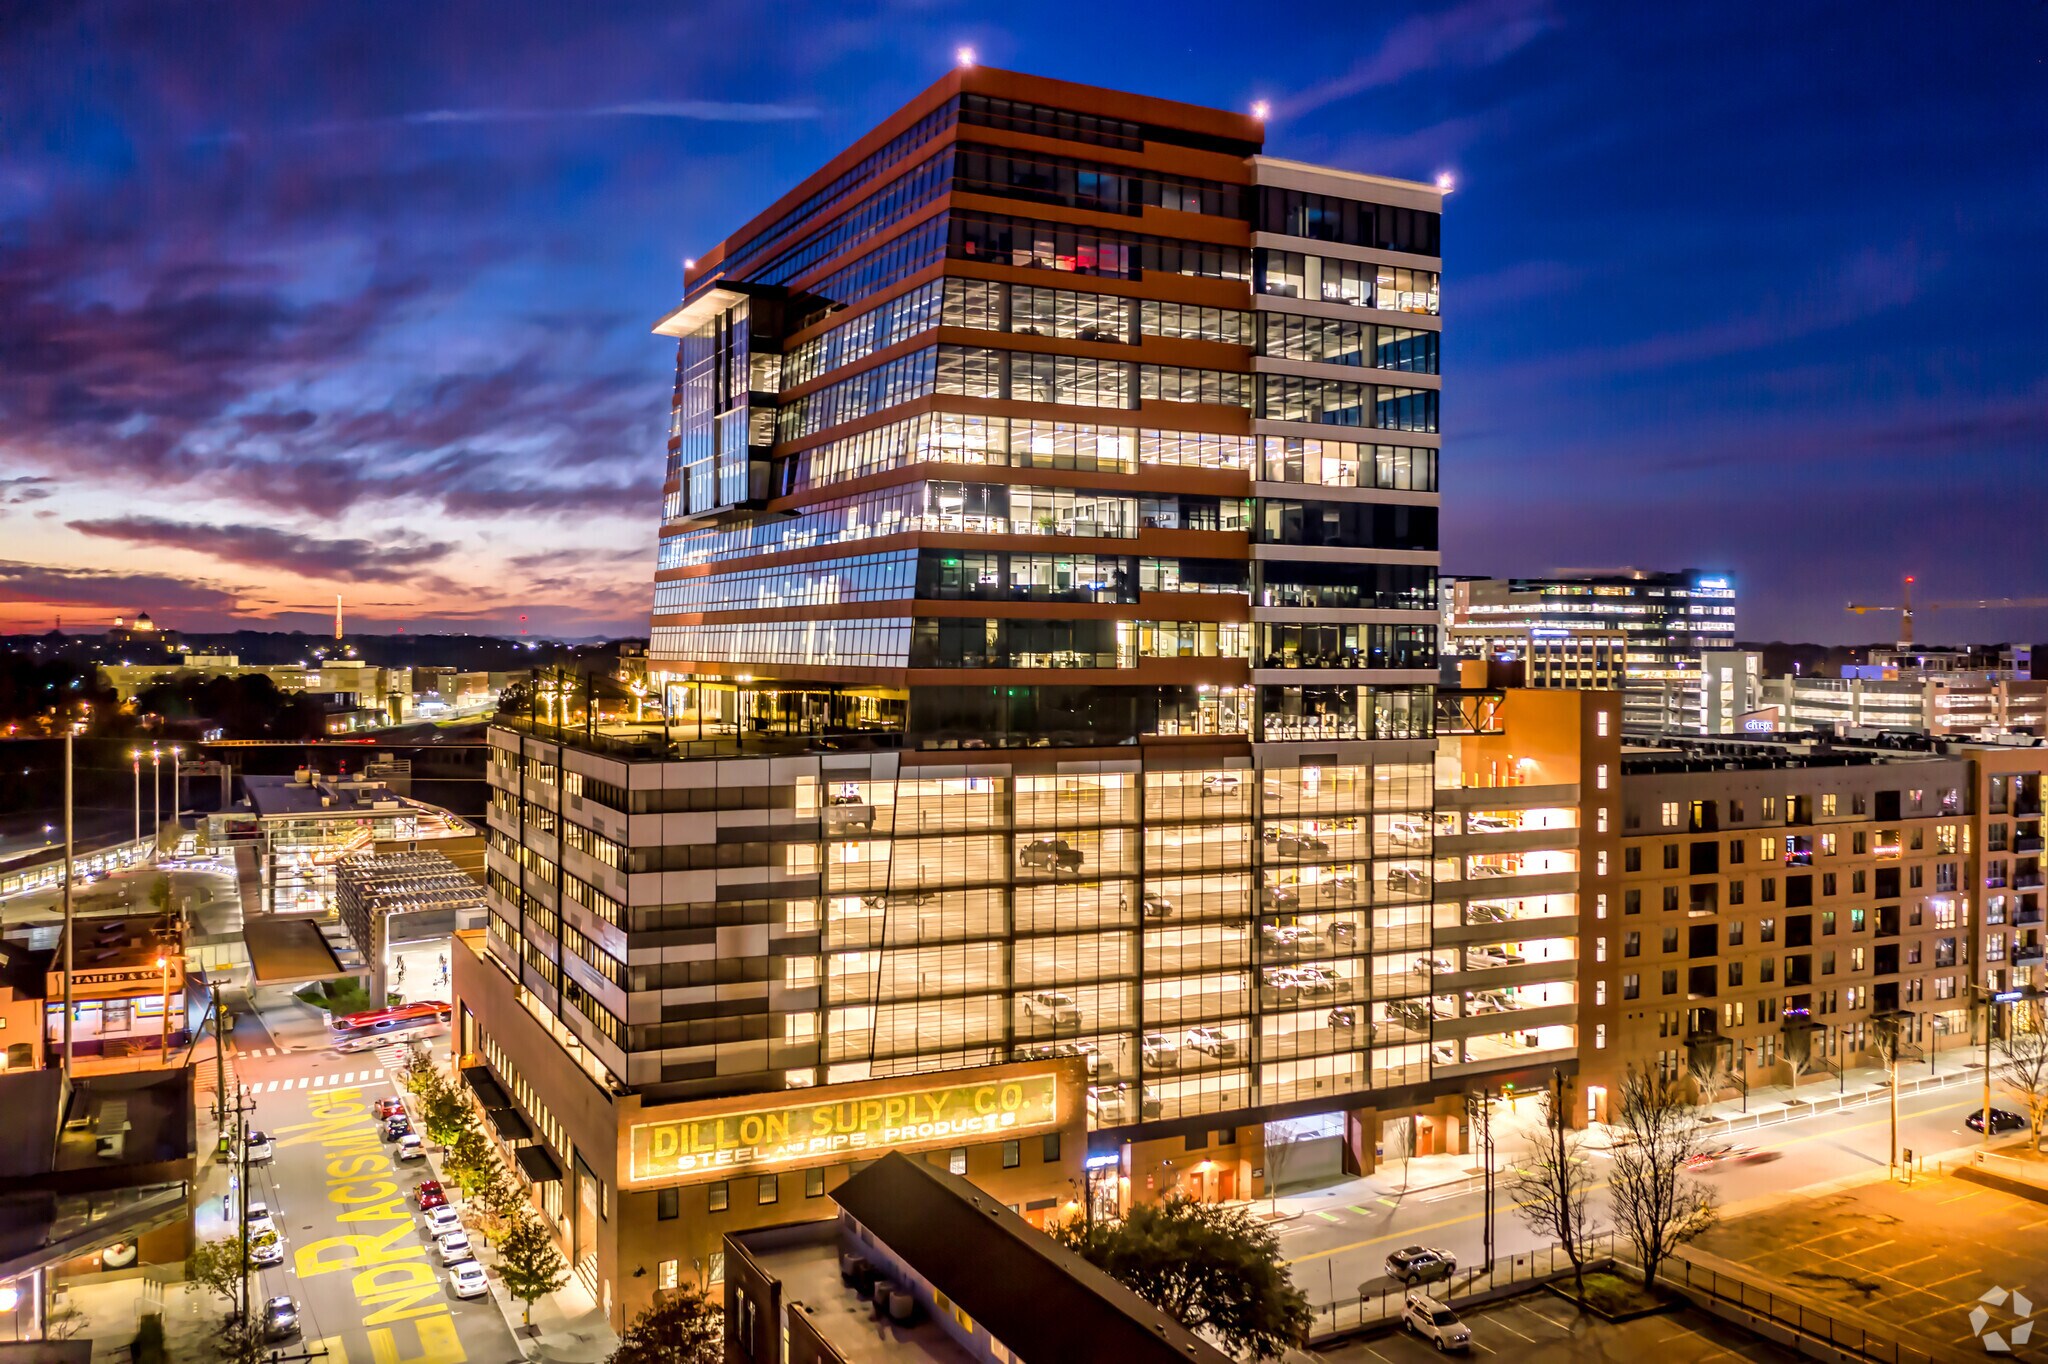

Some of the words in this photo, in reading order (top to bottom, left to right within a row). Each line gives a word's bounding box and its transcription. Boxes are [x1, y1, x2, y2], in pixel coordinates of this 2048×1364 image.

[75, 973, 125, 984] FATHER
[272, 1087, 373, 1149] NOW
[654, 1112, 790, 1158] DILLON
[812, 1091, 949, 1136] SUPPLY
[974, 1083, 1031, 1115] CO.
[678, 1146, 770, 1170] STEEL
[776, 1141, 805, 1154] AND
[809, 1132, 867, 1150] PIPE
[884, 1112, 1016, 1142] PRODUCTS
[294, 1127, 426, 1279] RACISM
